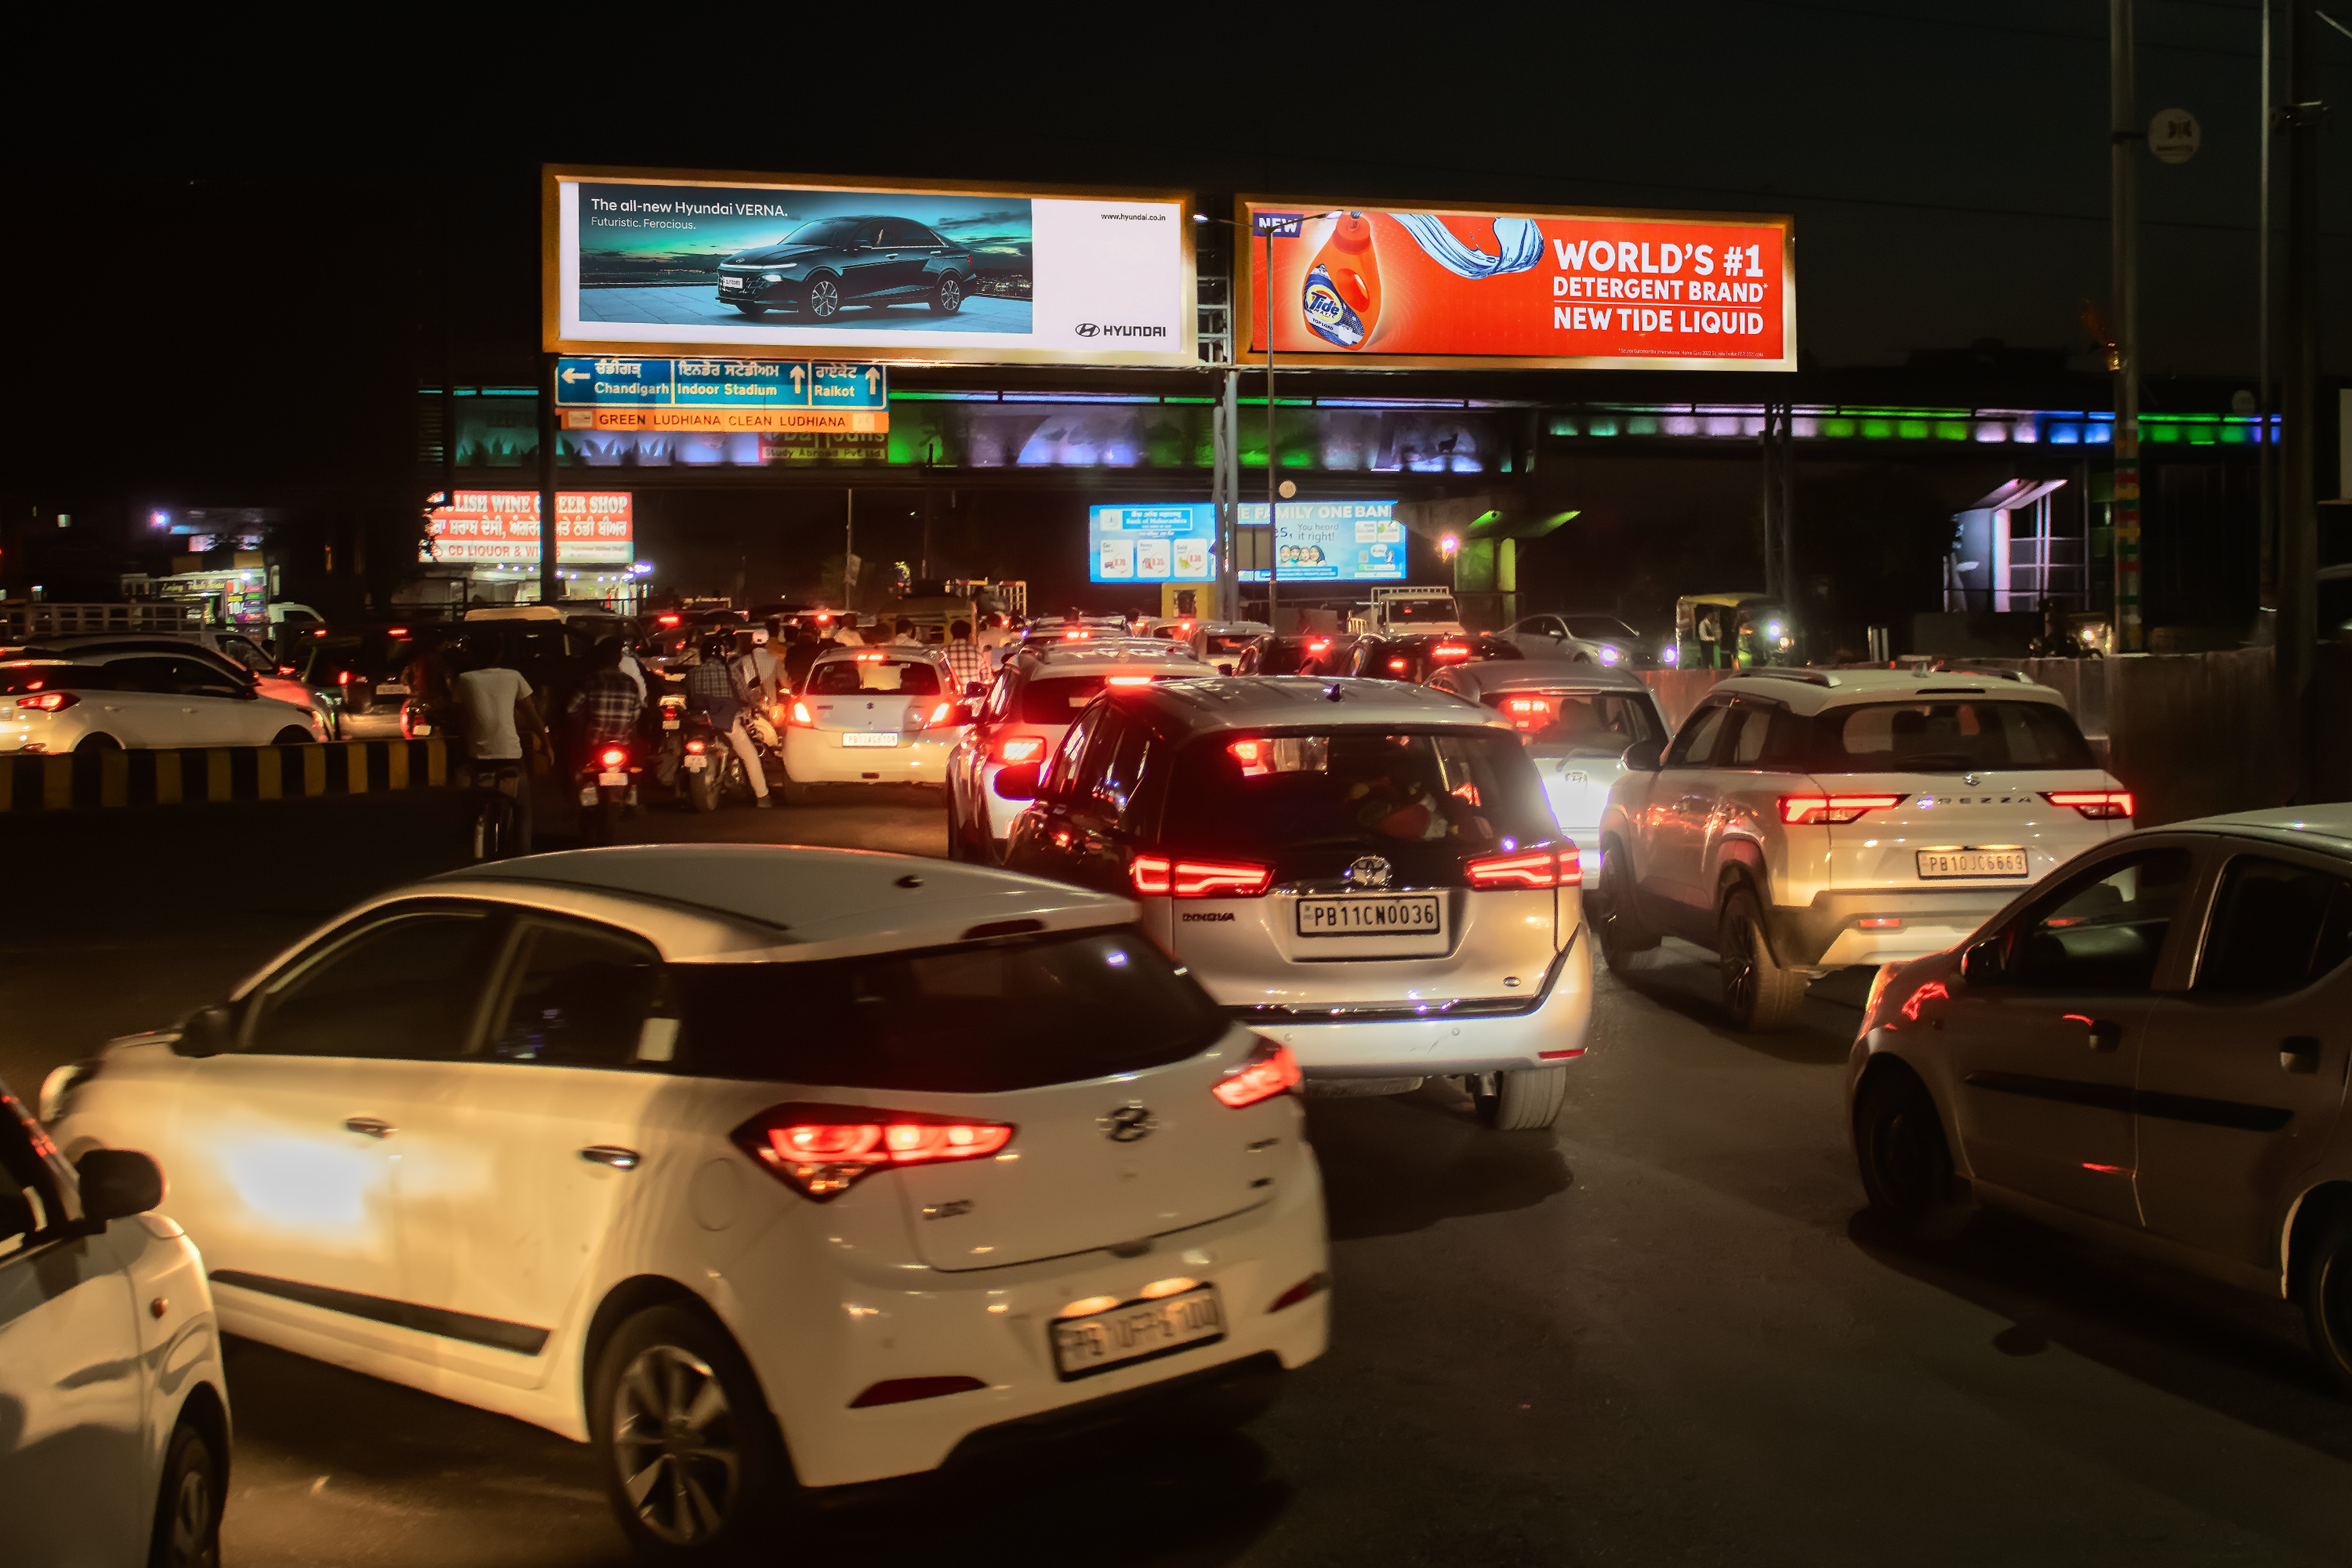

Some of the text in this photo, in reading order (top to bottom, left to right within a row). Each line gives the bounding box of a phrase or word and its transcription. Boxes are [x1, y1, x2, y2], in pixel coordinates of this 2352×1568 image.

[591, 198, 788, 217] The all-new Hyundai VERNA.
[591, 216, 696, 230] Futuristic. Ferocious.
[1258, 217, 1299, 233] NEW
[1723, 245, 1764, 277] #1
[1553, 276, 1684, 300] DETERGENT
[1309, 292, 1340, 315] Tide
[1314, 308, 1337, 319] MATIC
[1554, 307, 1764, 335] NEW TIDE LIQUID
[1103, 325, 1167, 337] HYUNDAI
[594, 382, 669, 397] Chandigarh
[677, 383, 777, 395] Indoor Stadium
[815, 384, 855, 397] Raikot
[600, 414, 645, 425] GREEN
[654, 415, 721, 426] LUDHIANA
[728, 416, 771, 426] CLEAN
[780, 416, 846, 427] LUDHIANA
[766, 448, 793, 458] Study
[800, 448, 838, 457] Abroad
[491, 495, 531, 513] WINE
[556, 495, 586, 514] EER
[590, 495, 628, 514] SHOP
[1318, 506, 1352, 518] ONE
[1298, 523, 1314, 532] You
[1298, 532, 1335, 543] it right!
[448, 545, 463, 557] CD
[468, 545, 510, 557] LIQUOR
[514, 546, 521, 557] &
[1929, 855, 2023, 872] PB10JC6669
[1314, 904, 1435, 927] PB11CN0036
